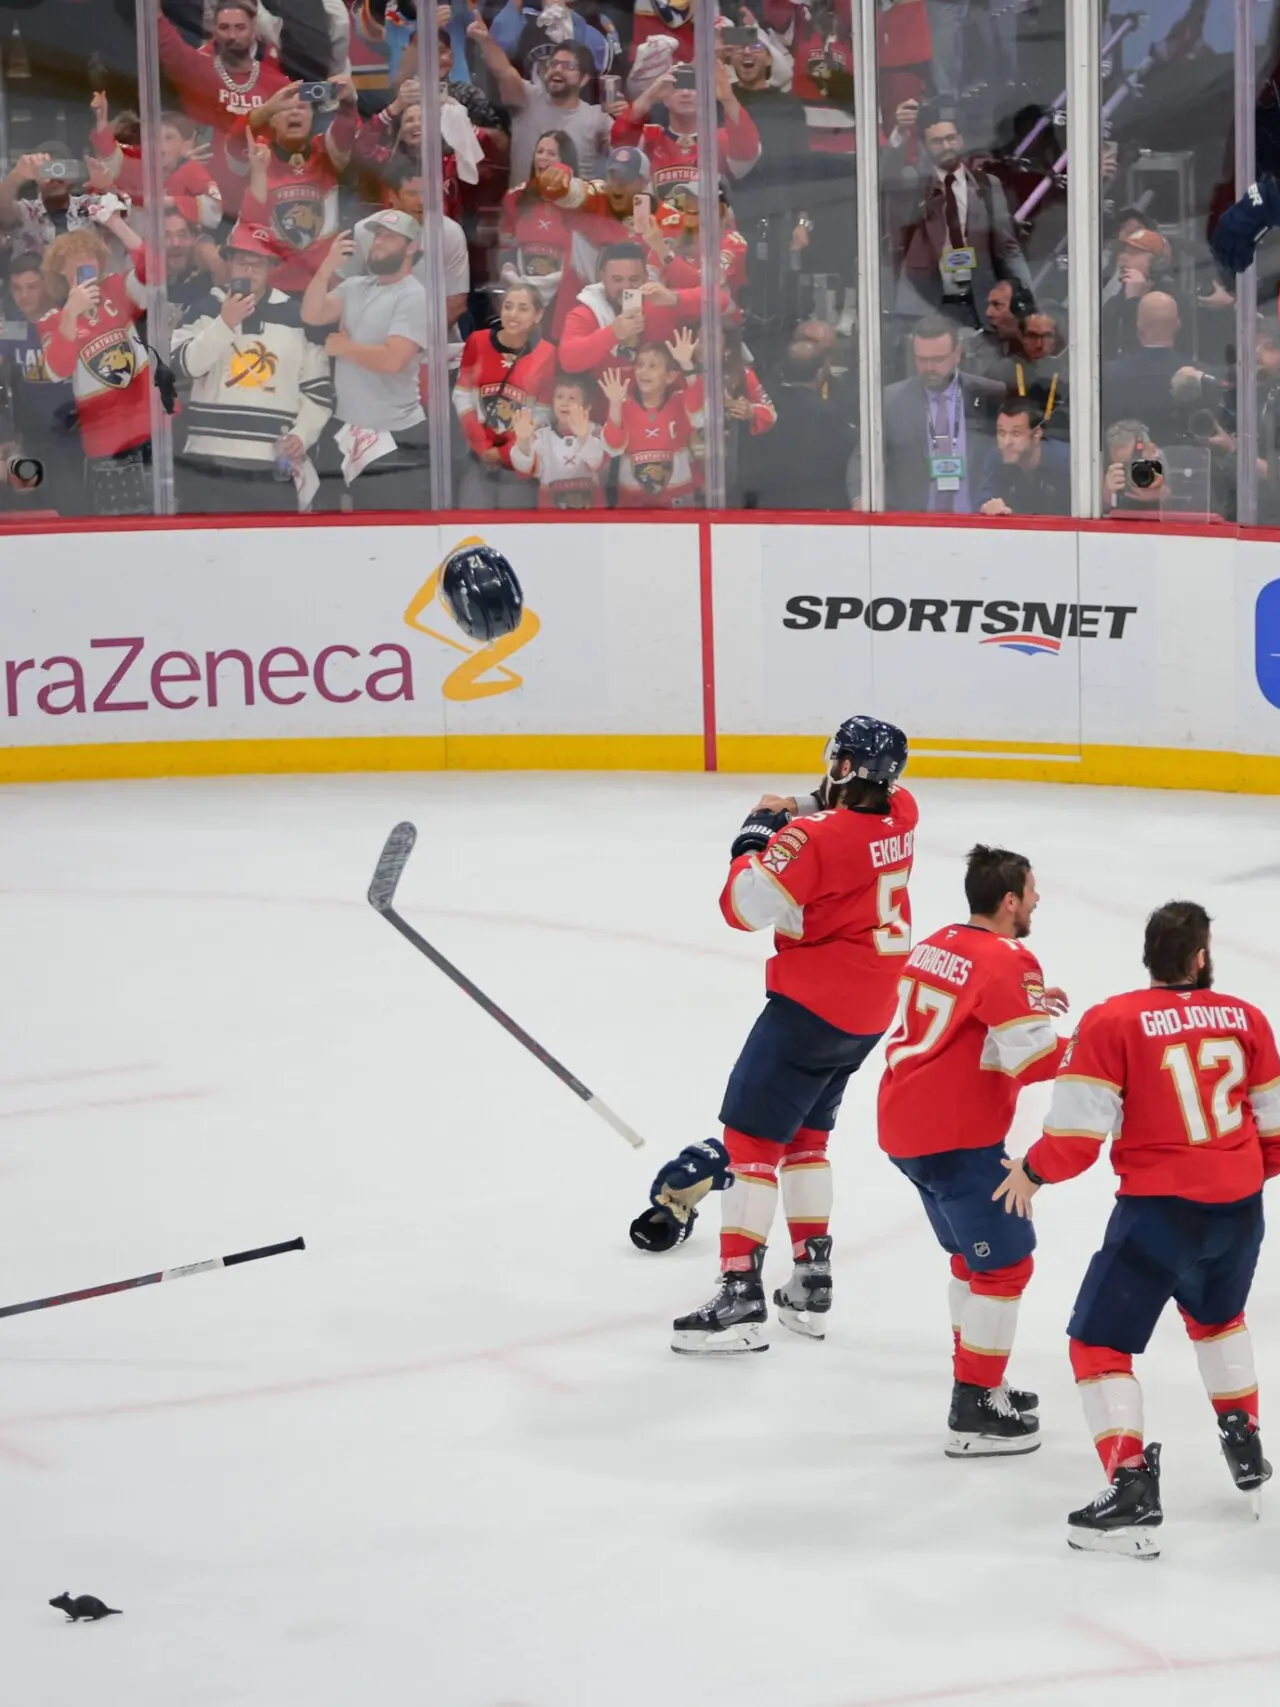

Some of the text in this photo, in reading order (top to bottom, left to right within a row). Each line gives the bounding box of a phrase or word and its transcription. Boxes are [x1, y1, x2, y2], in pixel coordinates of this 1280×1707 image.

[219, 88, 263, 107] POLO
[657, 170, 699, 183] PANTHE
[104, 299, 118, 317] C
[783, 595, 1137, 639] SPORTSNET
[5, 636, 415, 716] raZeneca
[888, 761, 898, 773] 5
[871, 866, 912, 956] 5
[1140, 1005, 1248, 1037] GADJOVICH
[1160, 1036, 1247, 1146] 12
